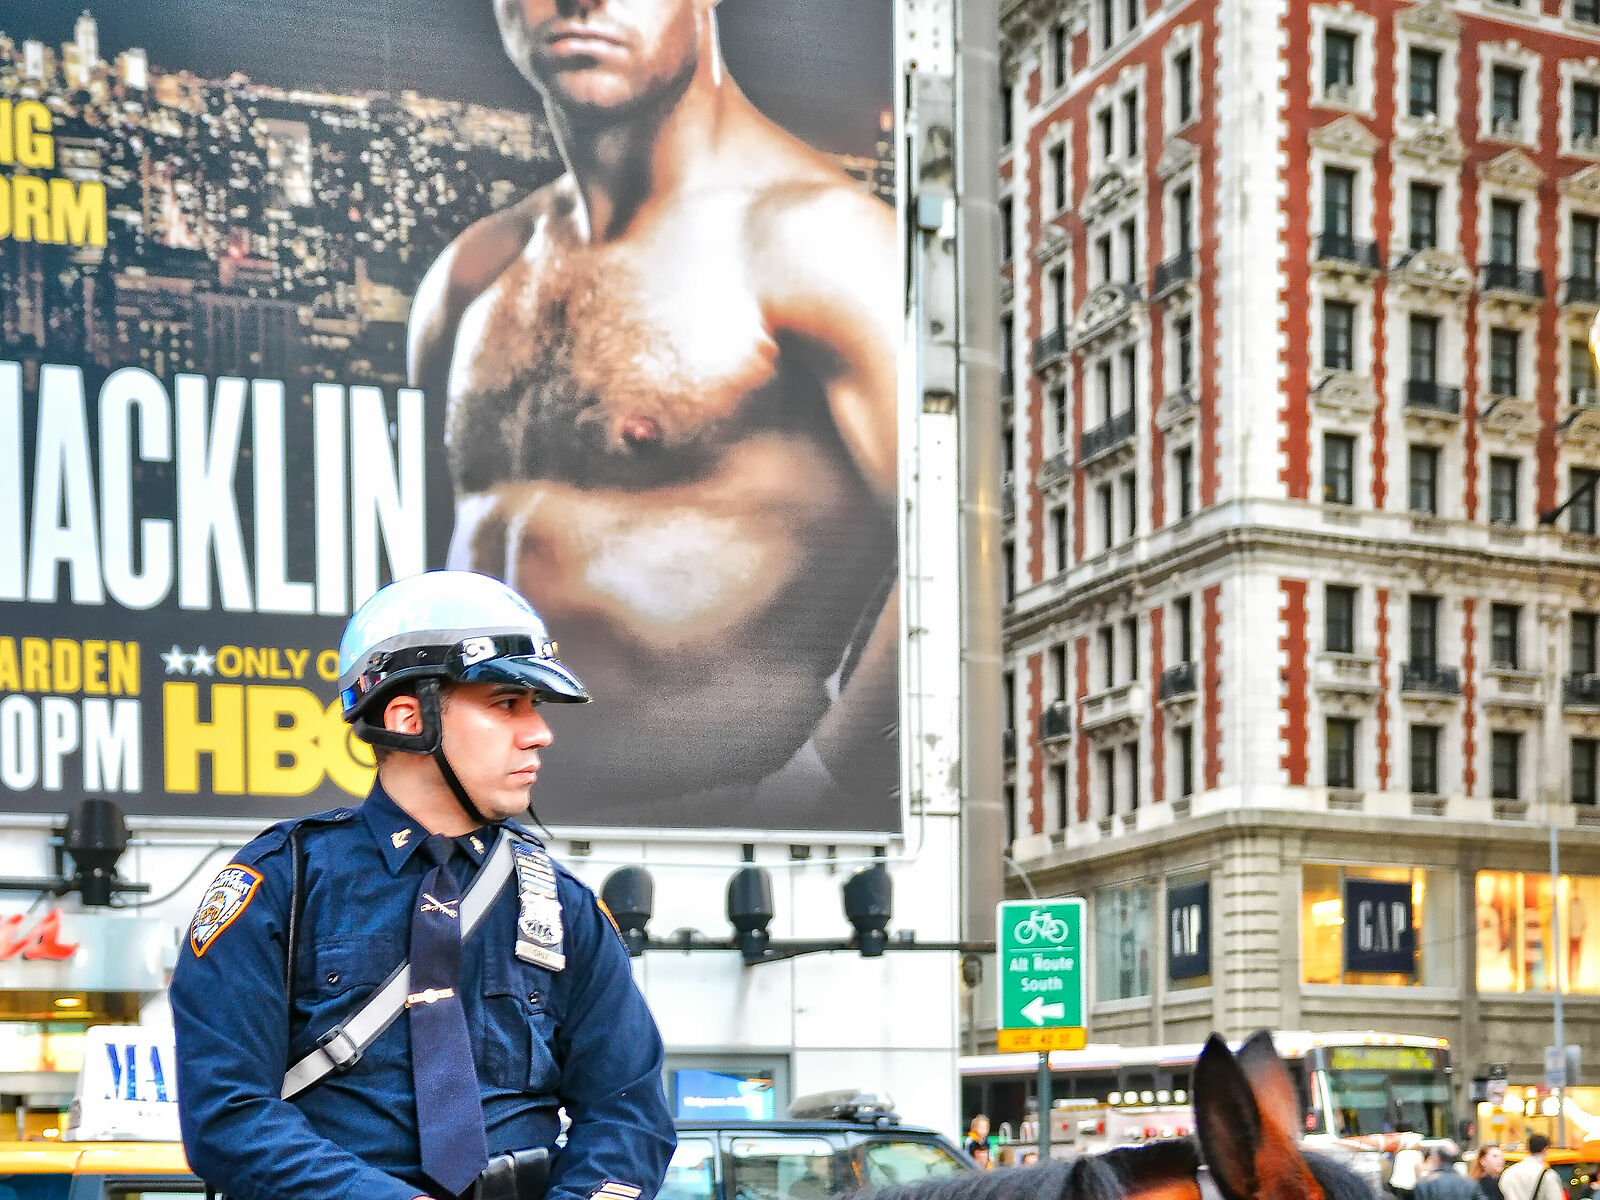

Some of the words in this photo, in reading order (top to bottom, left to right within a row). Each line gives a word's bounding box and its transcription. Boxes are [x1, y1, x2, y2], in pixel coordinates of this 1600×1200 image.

[215, 645, 309, 679] ONLY
[1358, 899, 1406, 951] GAP
[1034, 956, 1074, 971] Route
[1020, 976, 1063, 992] South
[104, 1043, 180, 1102] MA
